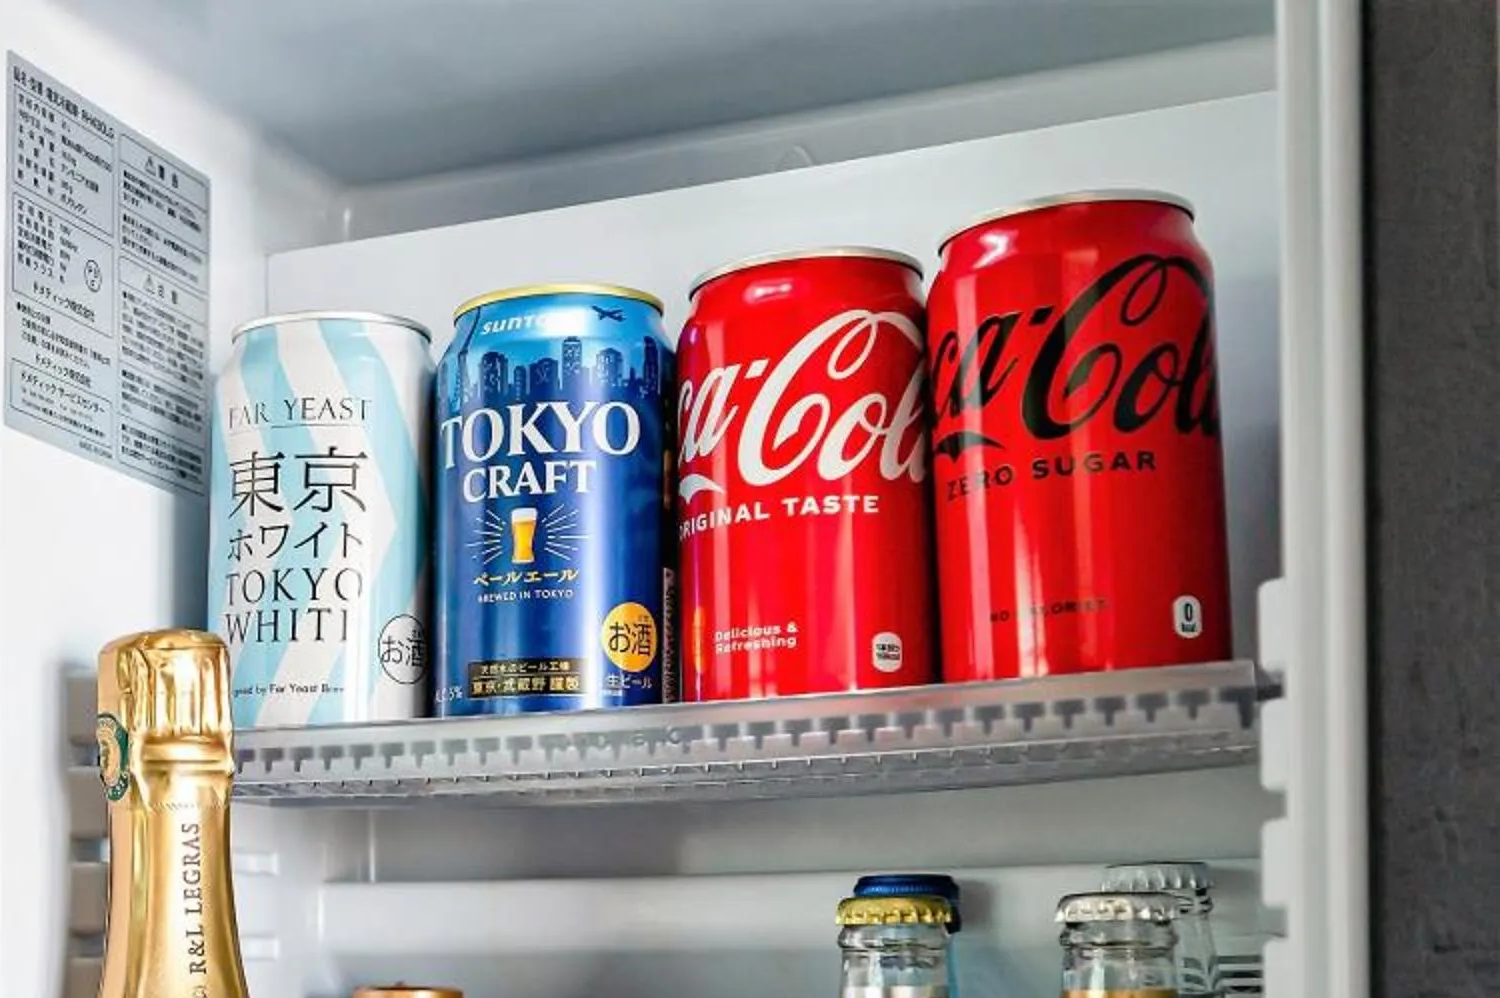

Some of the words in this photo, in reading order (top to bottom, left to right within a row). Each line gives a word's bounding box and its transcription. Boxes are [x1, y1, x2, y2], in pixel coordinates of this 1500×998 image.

[228, 403, 269, 429] FAR
[284, 397, 372, 420] YEAST
[441, 401, 641, 469] TOKYO
[228, 446, 368, 518] 東京
[463, 460, 597, 503] CRAFT
[946, 465, 1014, 500] ZERO
[1032, 451, 1156, 480] SUGAR
[782, 495, 880, 517] TASTE
[227, 521, 363, 562] ホワイト
[225, 567, 363, 606] TOKYO
[473, 569, 579, 587] ペールエール
[534, 588, 574, 600] TOKYO
[1184, 602, 1193, 621] 0
[609, 621, 651, 655] お酒
[715, 624, 782, 642] Delicious
[787, 621, 798, 633] &
[715, 636, 797, 655] Refreshing
[182, 823, 203, 916] LEGRAS
[186, 924, 207, 974] R&L
